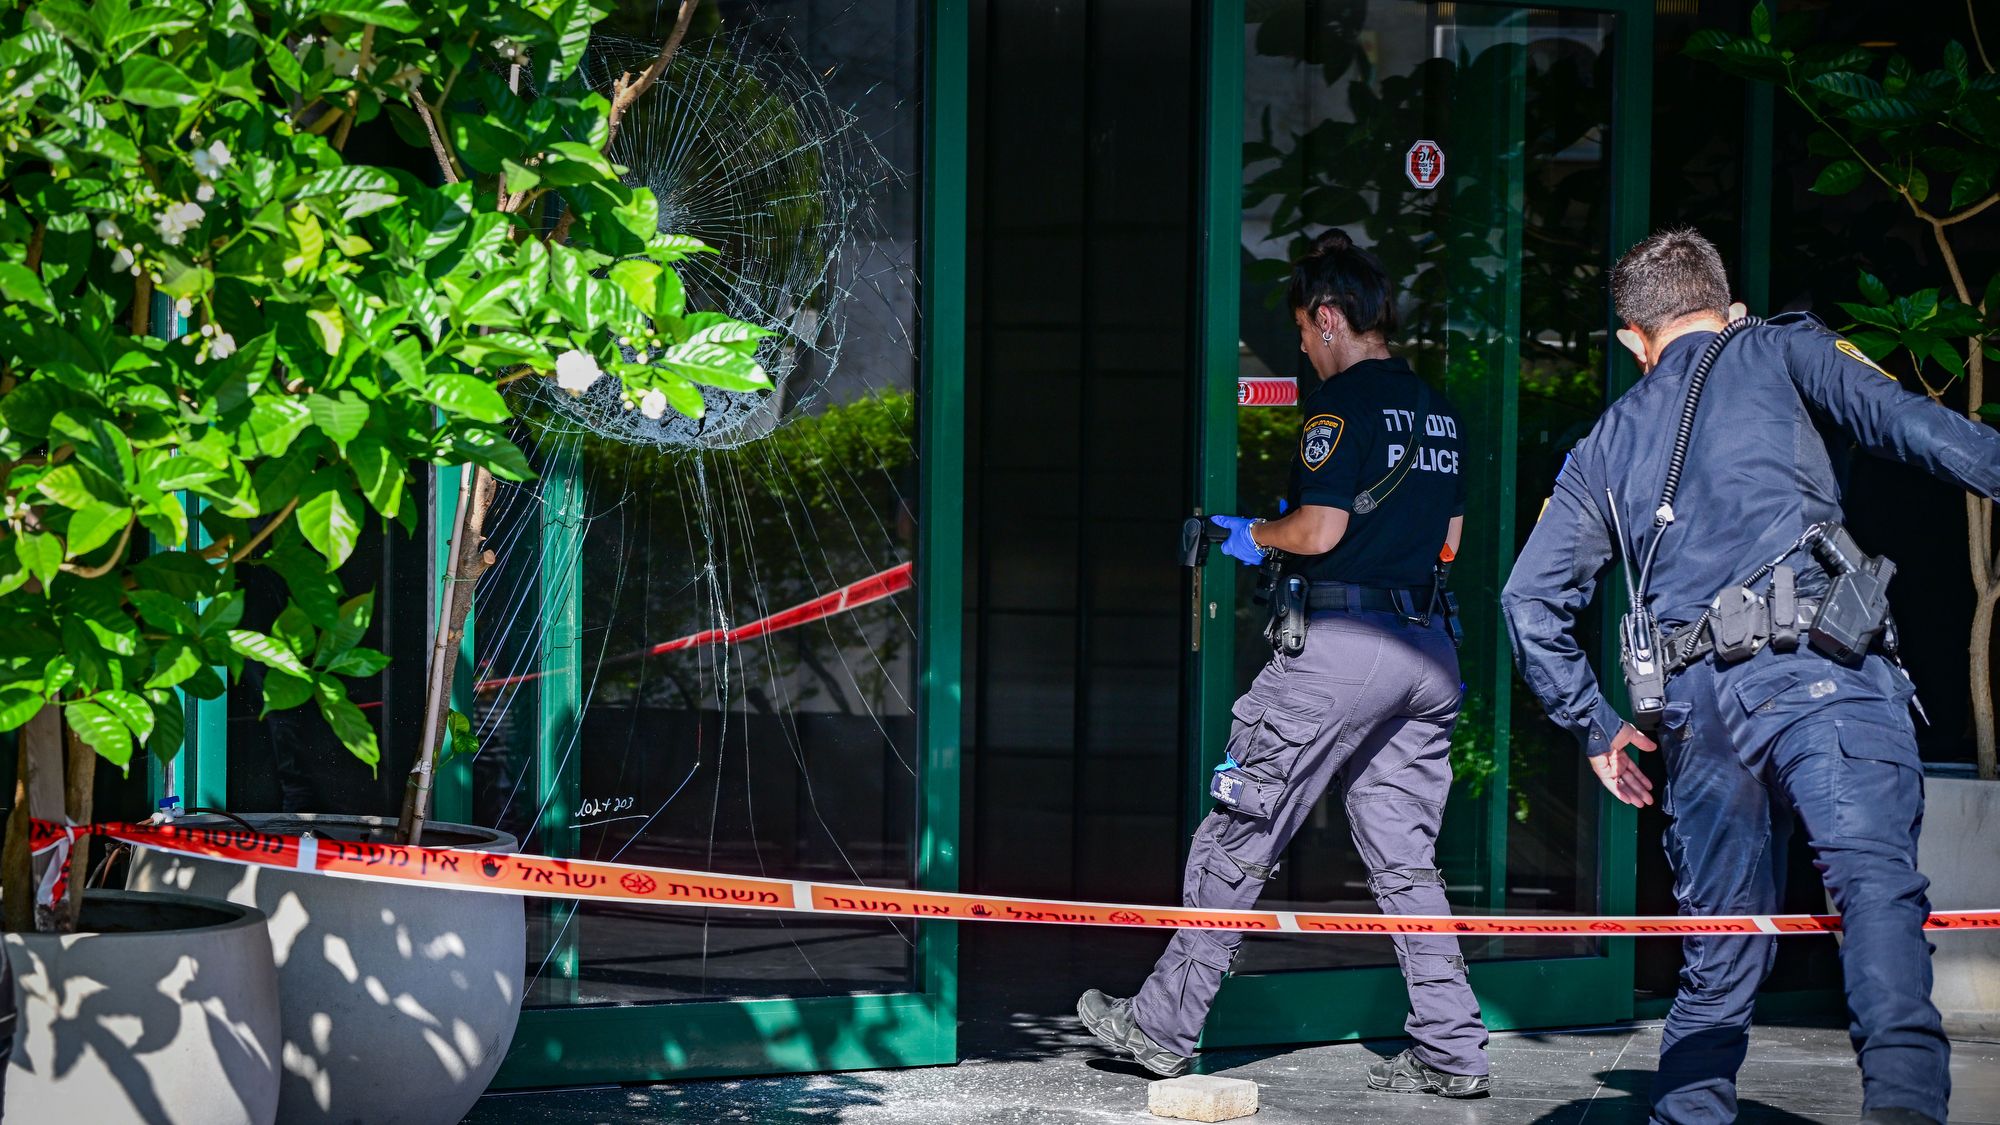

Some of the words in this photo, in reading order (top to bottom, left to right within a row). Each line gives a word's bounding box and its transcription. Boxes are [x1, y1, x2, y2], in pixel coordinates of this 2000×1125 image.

[1383, 409, 1457, 439] משרה
[1387, 444, 1459, 475] PLICE
[331, 841, 409, 867] מעבר
[421, 852, 459, 875] אין
[516, 862, 606, 888] ישראל
[668, 883, 779, 904] משטרת
[823, 896, 902, 913] מעבר
[912, 903, 950, 915] אין
[1006, 906, 1096, 921] ישראל
[1156, 917, 1266, 929] משטרת
